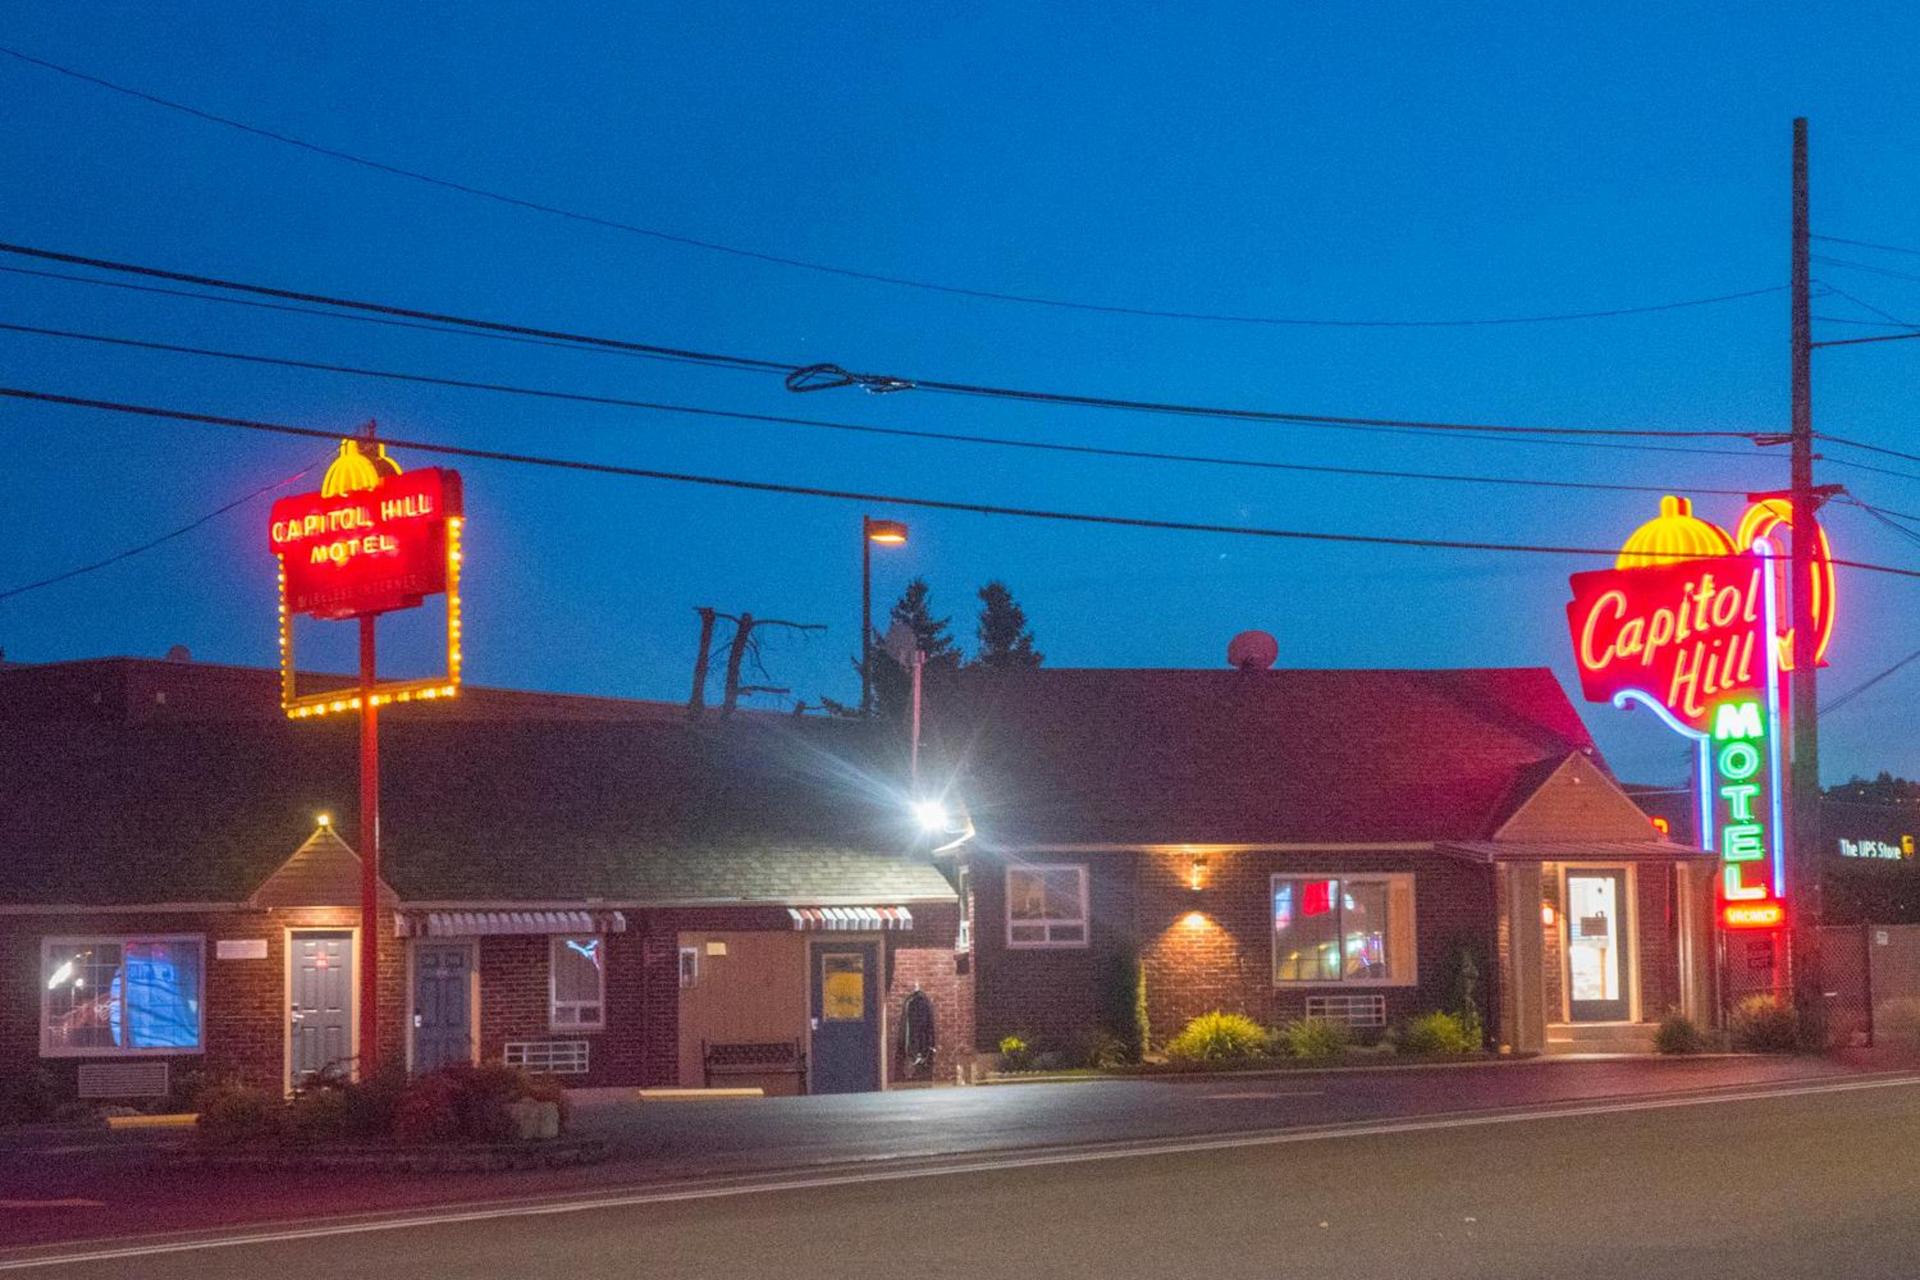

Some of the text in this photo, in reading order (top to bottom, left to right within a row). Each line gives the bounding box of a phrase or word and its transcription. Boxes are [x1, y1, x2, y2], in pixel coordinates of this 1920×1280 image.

[272, 494, 431, 543] CAPITOL HILL
[310, 534, 395, 565] MOTEL
[1580, 567, 1761, 671] Capitol
[1667, 629, 1755, 718] Hill
[1714, 701, 1767, 901] MOTEL
[1839, 838, 1902, 860] The UPS Store
[1727, 908, 1778, 924] VACANCY
